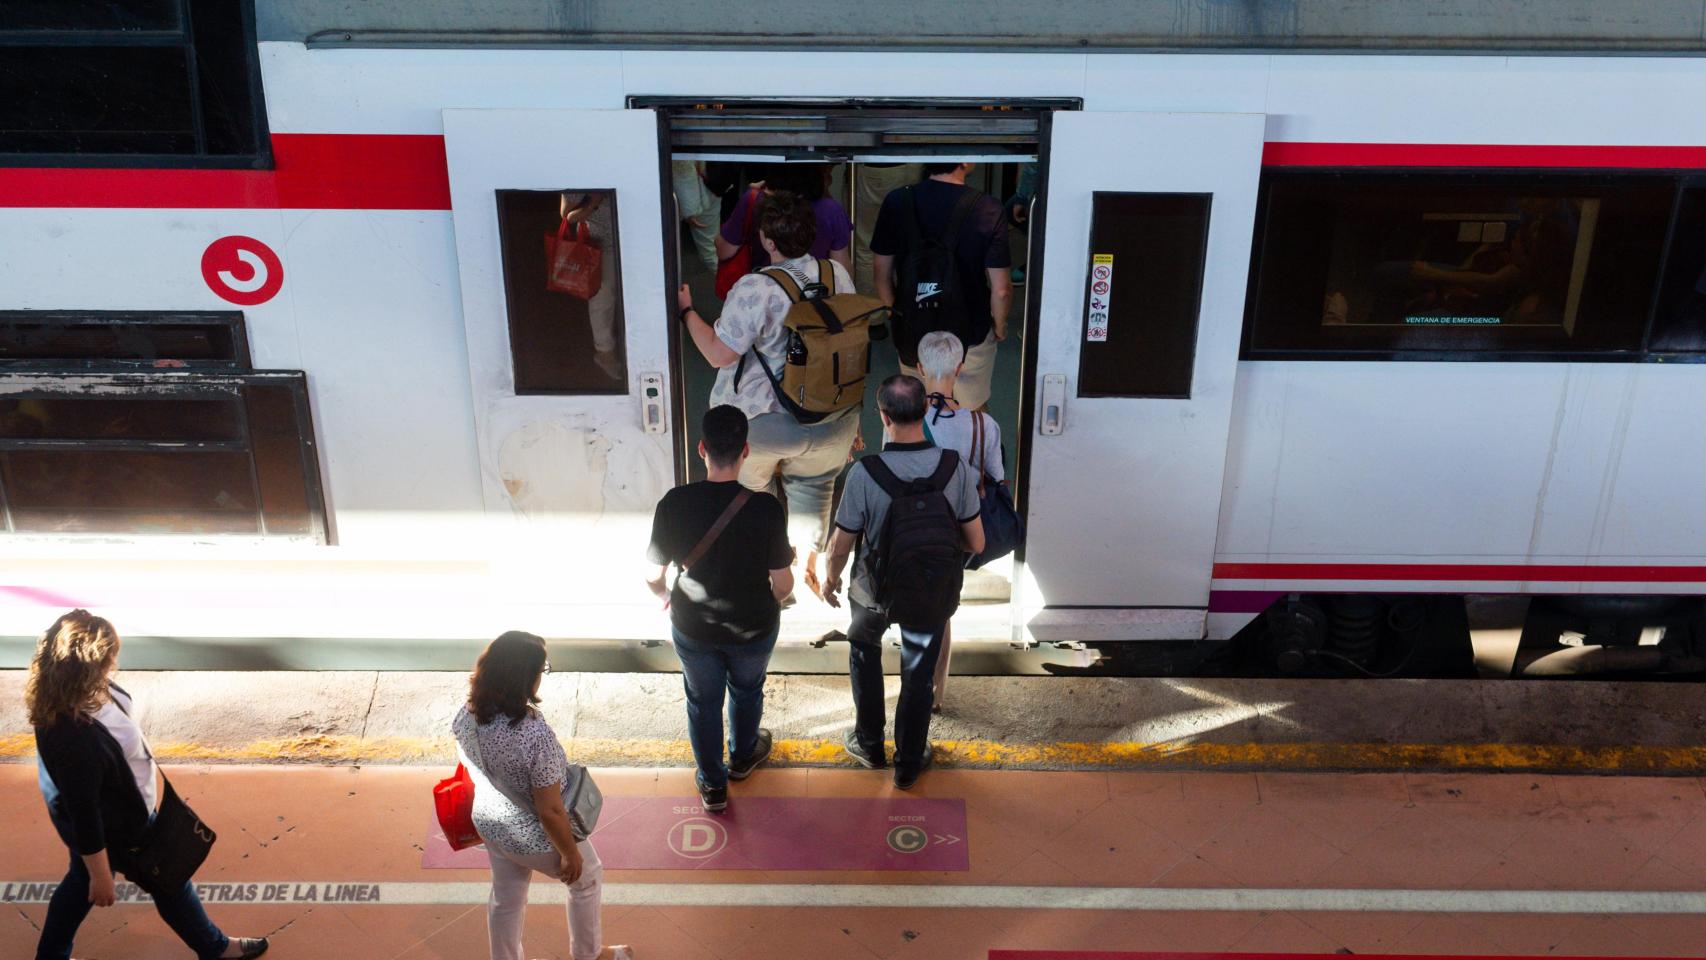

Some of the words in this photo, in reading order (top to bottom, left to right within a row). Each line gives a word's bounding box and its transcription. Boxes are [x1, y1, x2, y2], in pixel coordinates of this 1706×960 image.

[917, 282, 938, 293] NIKE
[1405, 316, 1439, 324] VENTANA
[1440, 316, 1451, 324] DE
[1452, 316, 1500, 324] EMERGENCIA
[672, 806, 705, 815] SECT
[681, 824, 716, 851] D
[895, 829, 920, 849] C
[2, 883, 58, 901] LINE
[196, 885, 258, 901] ETRAS
[262, 884, 289, 901] DE
[293, 884, 317, 901] LA
[323, 884, 381, 901] LINEA
